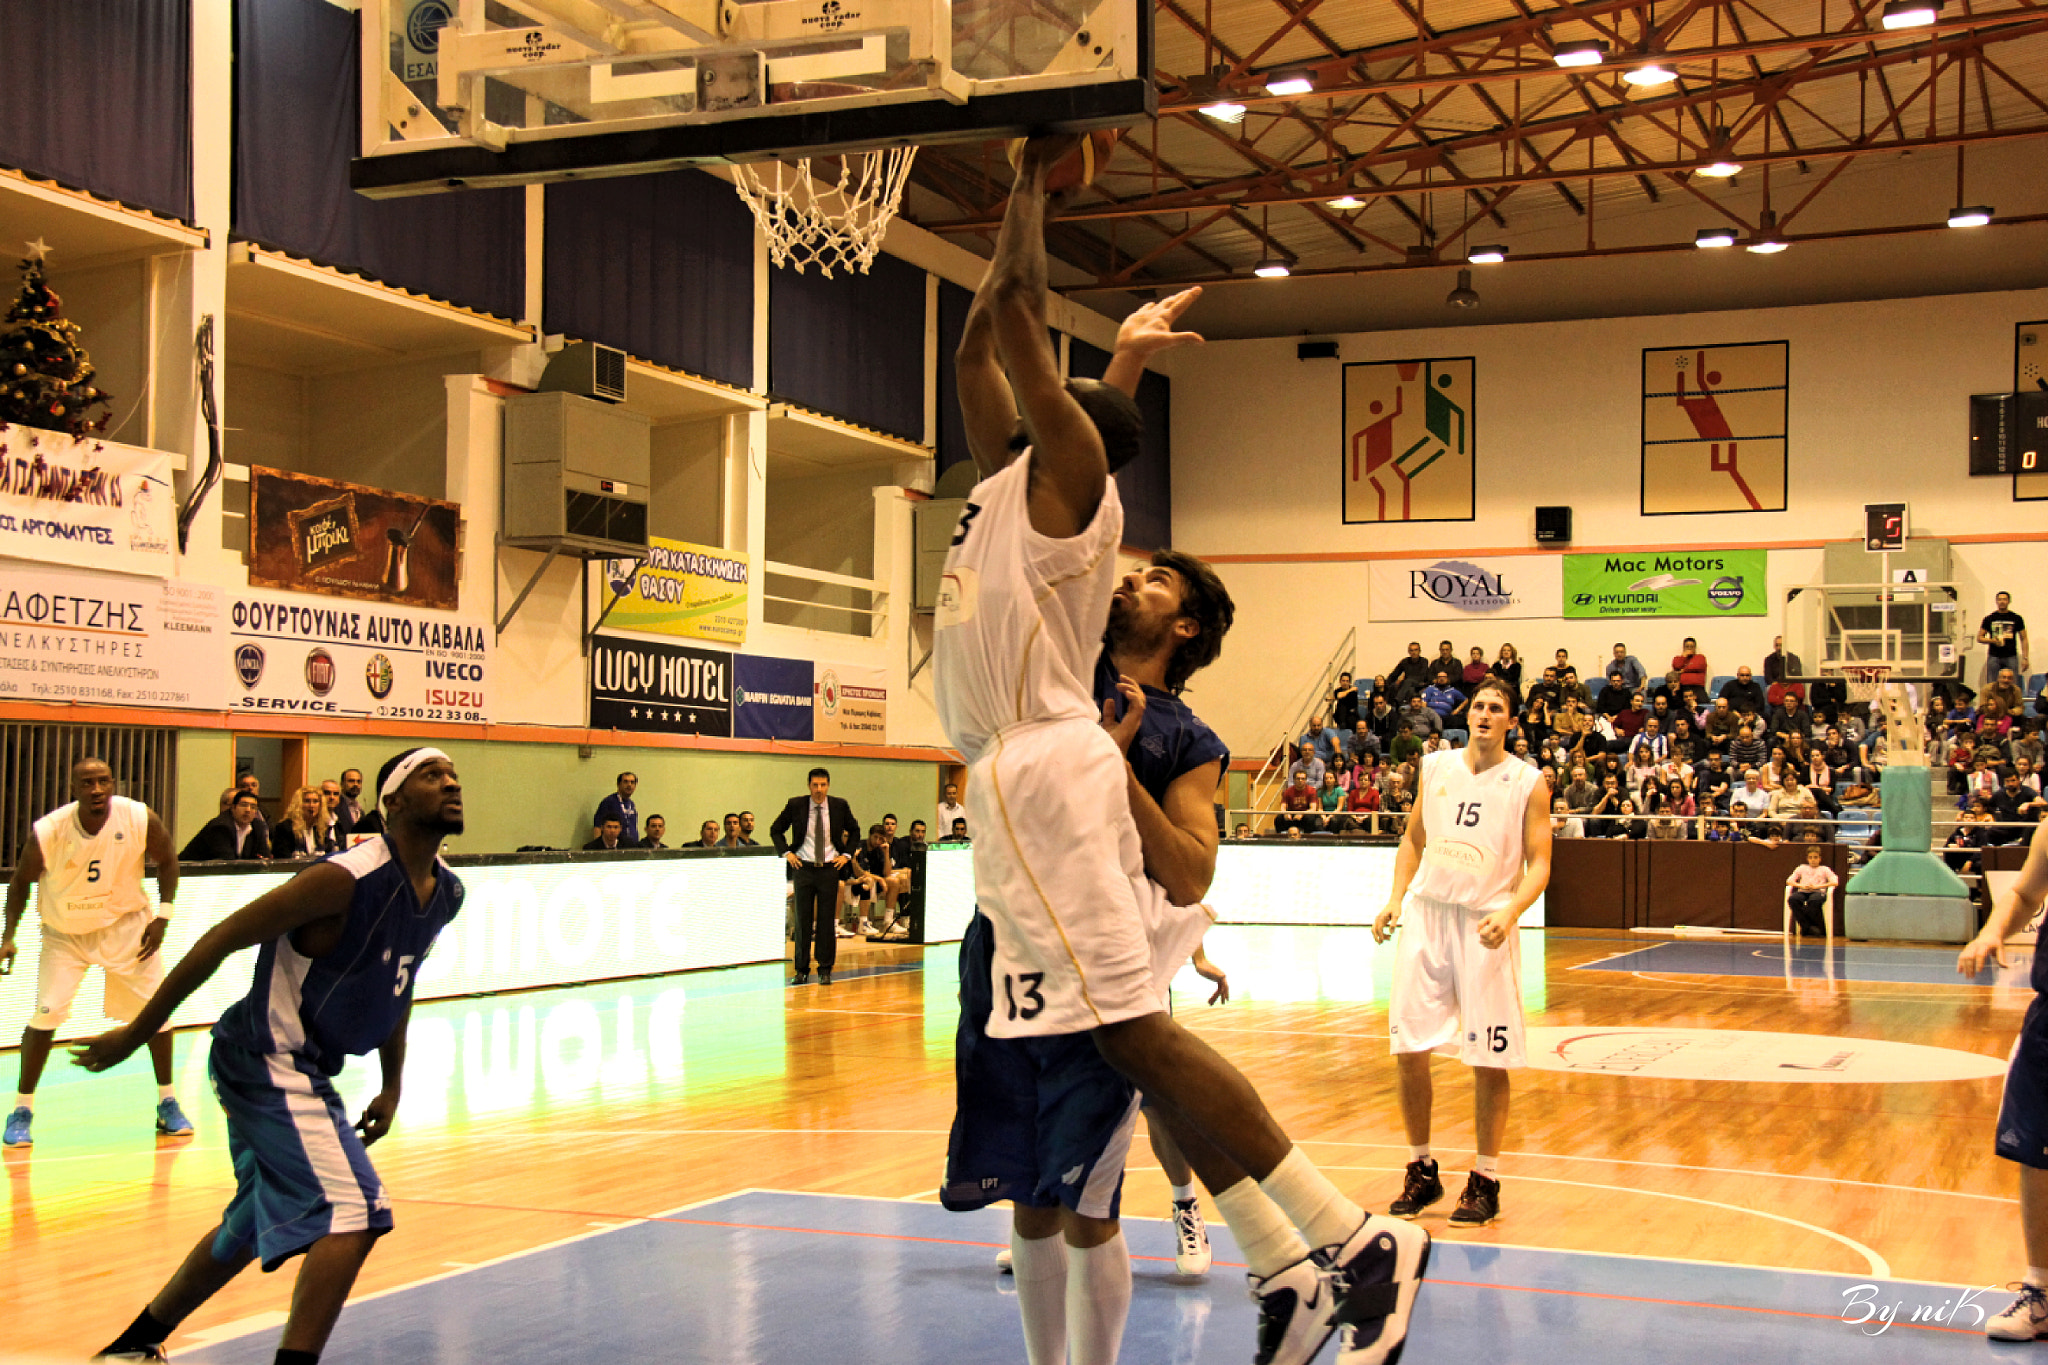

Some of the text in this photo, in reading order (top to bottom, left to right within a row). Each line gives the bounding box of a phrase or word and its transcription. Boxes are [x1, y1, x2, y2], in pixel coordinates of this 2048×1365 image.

[833, 12, 861, 21] radar
[407, 61, 438, 79] ΕΣΑ
[2021, 451, 2037, 469] 0
[22, 518, 114, 545] ΑΡΓΟΝΑΥΤΕΣ
[1604, 556, 1724, 572] Mac Motors
[640, 574, 684, 604] ΘΑΣΟΥ
[1408, 570, 1513, 603] ROYAL
[1598, 593, 1659, 604] HYUNDAI
[0, 590, 144, 632] ΑΦΕΤΖΗΣ
[1600, 605, 1620, 613] Drive
[164, 621, 212, 633] KLEEMANN
[232, 600, 361, 640] ΦΟΥΡΤΟΥΝΑΣ
[366, 615, 413, 645] AUTO
[419, 621, 486, 652] ΚΑΒΑΛΑ
[31, 657, 38, 671] &
[425, 660, 483, 681] IVECO
[594, 647, 729, 703] LUCY HOTEL
[54, 684, 77, 696] 2510
[136, 690, 158, 700] 2510
[425, 689, 483, 708] ISUZU
[242, 696, 338, 713] SERVICE
[390, 707, 480, 721] 2510 22 33 08
[1456, 802, 1482, 828] 15
[87, 860, 101, 882] 5
[392, 955, 416, 997] 5
[1004, 972, 1045, 1021] 13
[1486, 1025, 1509, 1053] 15
